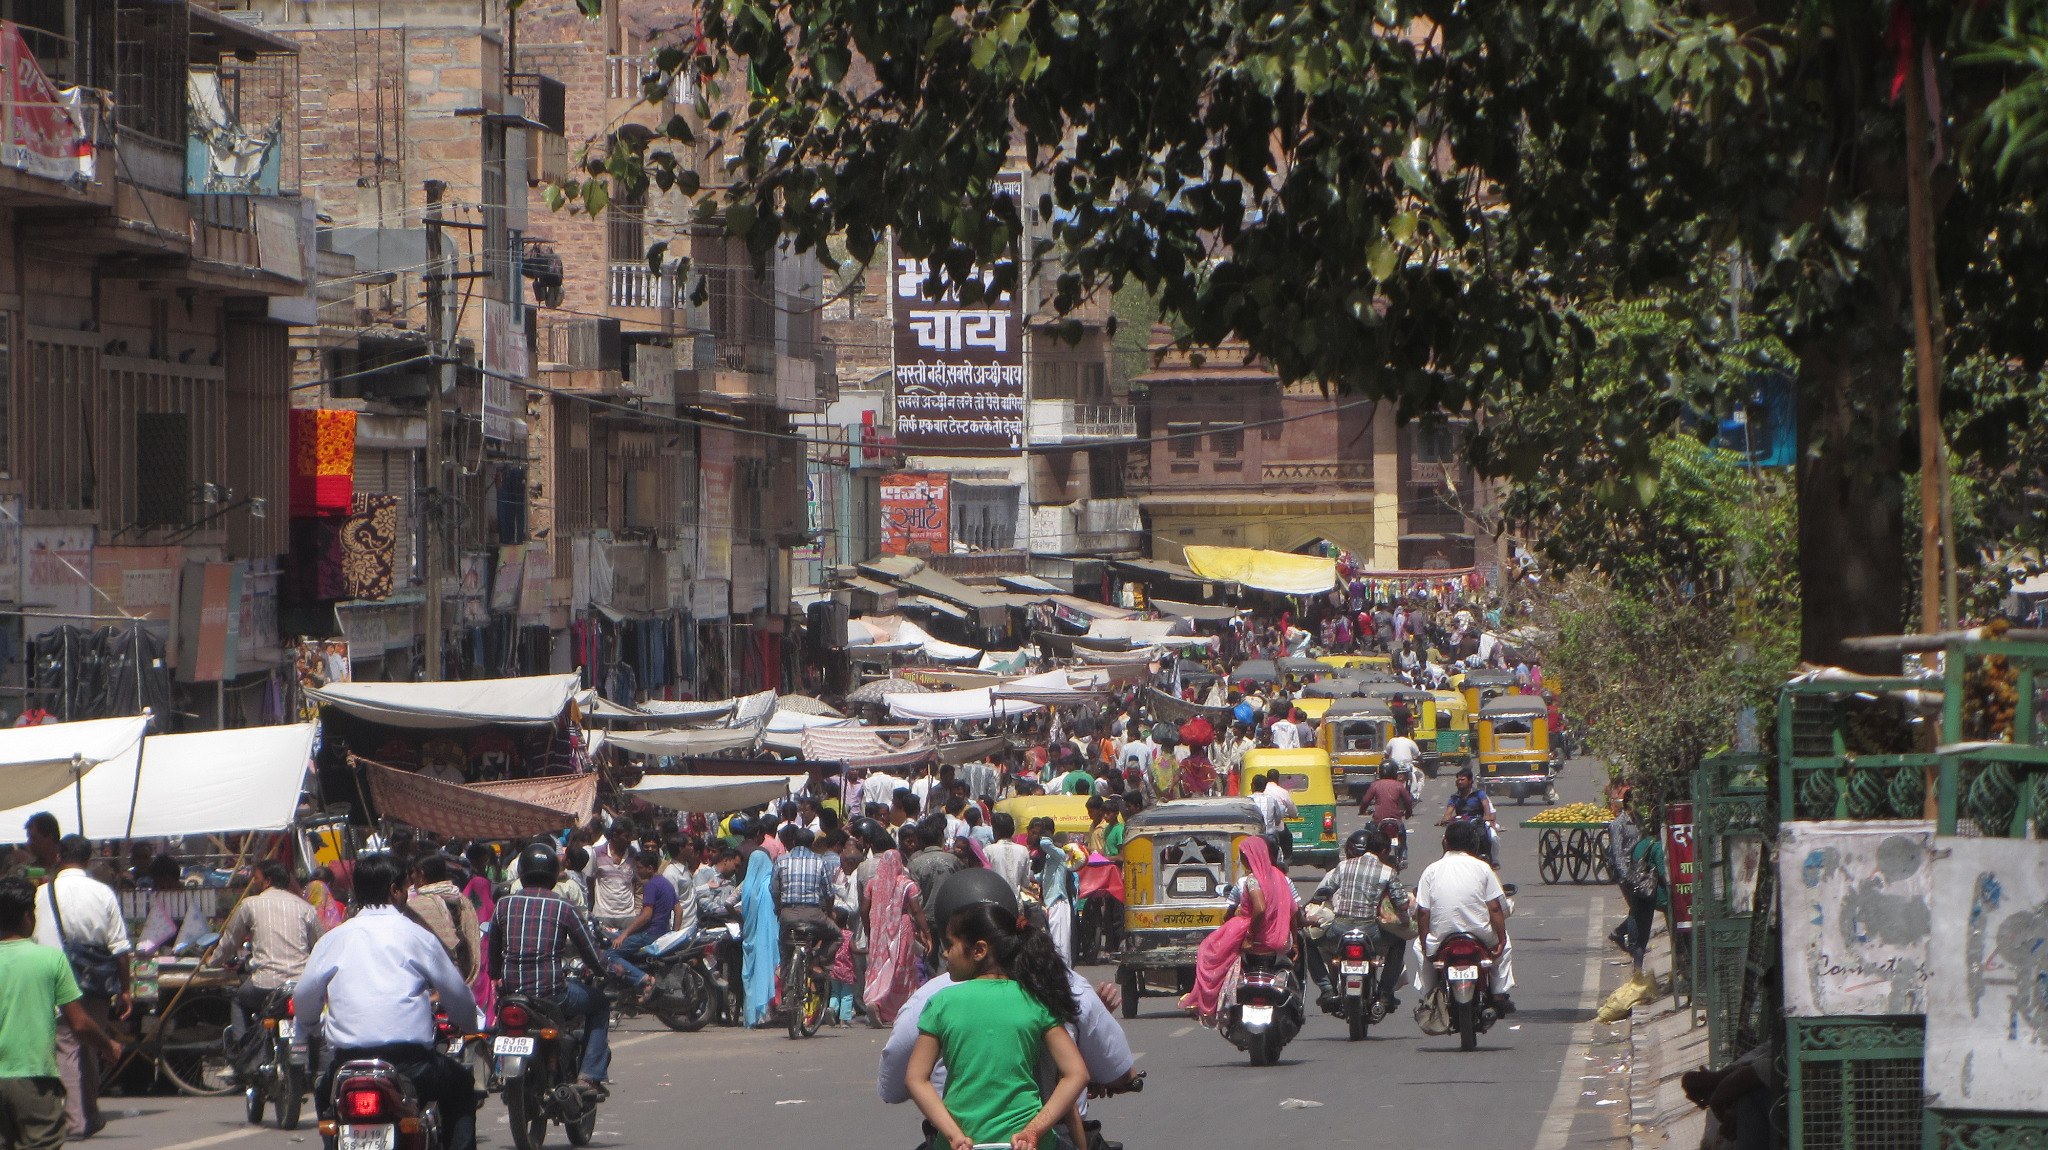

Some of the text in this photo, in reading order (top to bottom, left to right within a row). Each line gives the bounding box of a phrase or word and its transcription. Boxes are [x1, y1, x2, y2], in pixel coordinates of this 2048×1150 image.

[909, 310, 1011, 352] चाय
[896, 359, 926, 385] सस्ती
[946, 360, 973, 385] सबसे
[973, 360, 1001, 387] अच्छी
[1002, 365, 1022, 385] चाय
[921, 391, 947, 411] अच्छी
[973, 392, 984, 410] तो
[898, 414, 917, 433] सिर्फ
[948, 415, 970, 434] टेस्ट
[969, 415, 992, 434] करके
[1002, 416, 1022, 437] देखो
[353, 1129, 381, 1139] RJ 19
